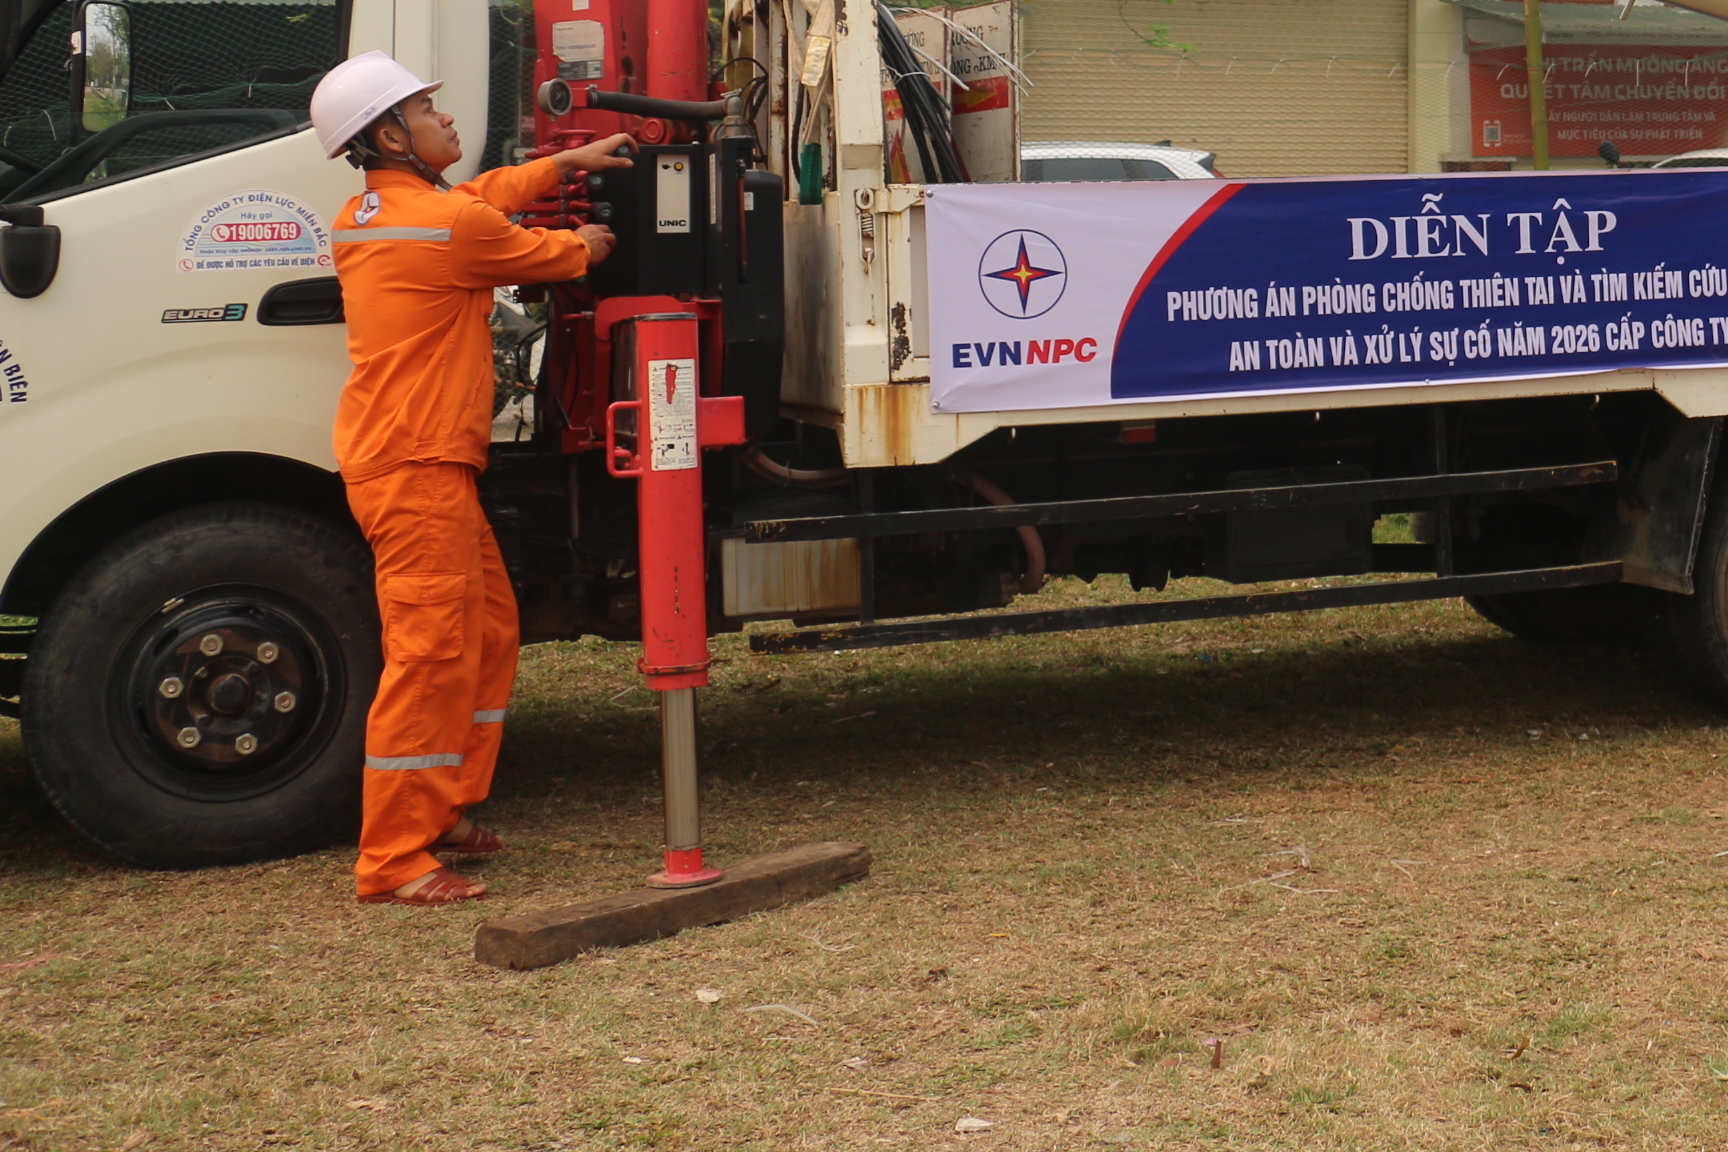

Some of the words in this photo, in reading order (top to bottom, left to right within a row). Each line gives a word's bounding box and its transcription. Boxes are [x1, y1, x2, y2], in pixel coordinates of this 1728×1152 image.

[1500, 76, 1568, 99] QUẾT
[1569, 79, 1612, 99] TÂM
[1614, 77, 1690, 99] CHUYỂN
[1693, 77, 1724, 99] ĐỔI
[184, 225, 203, 251] TỔNG
[201, 200, 231, 224] CÔNG
[232, 195, 245, 206] TY
[248, 192, 273, 203] ĐIỆN
[275, 196, 296, 209] LỰC
[295, 206, 318, 227] MIỀN
[313, 226, 328, 248] BẮC
[230, 222, 297, 241] 19006769
[240, 211, 256, 220] Hãy
[259, 211, 273, 221] gọi
[1346, 193, 1491, 260] DIỄN
[1507, 198, 1617, 265] TẬP
[1167, 286, 1258, 322] PHƯƠNG
[1265, 281, 1296, 318] ÁN
[1302, 278, 1376, 316] PHÒNG
[1382, 271, 1454, 312] CHỐNG
[1459, 272, 1519, 308] THIÊN
[1524, 276, 1554, 306] TAI
[1560, 269, 1587, 304] VÀ
[1591, 268, 1628, 303] TÌM
[1633, 262, 1683, 301] KIẾM
[1689, 263, 1727, 297] CỨU
[1229, 341, 1260, 372] AN
[1265, 332, 1324, 369] TOÀN
[1328, 330, 1359, 366] VÀ
[1363, 324, 1394, 365] XỬ
[1399, 326, 1423, 363] LÝ
[1430, 328, 1459, 367] SỰ
[1463, 318, 1492, 359] CỐ
[1497, 321, 1546, 358] NĂM
[1551, 324, 1600, 354] 2026
[1605, 311, 1646, 351] CẤP
[1651, 314, 1704, 348] CÔNG
[3, 363, 28, 403] BIÊN
